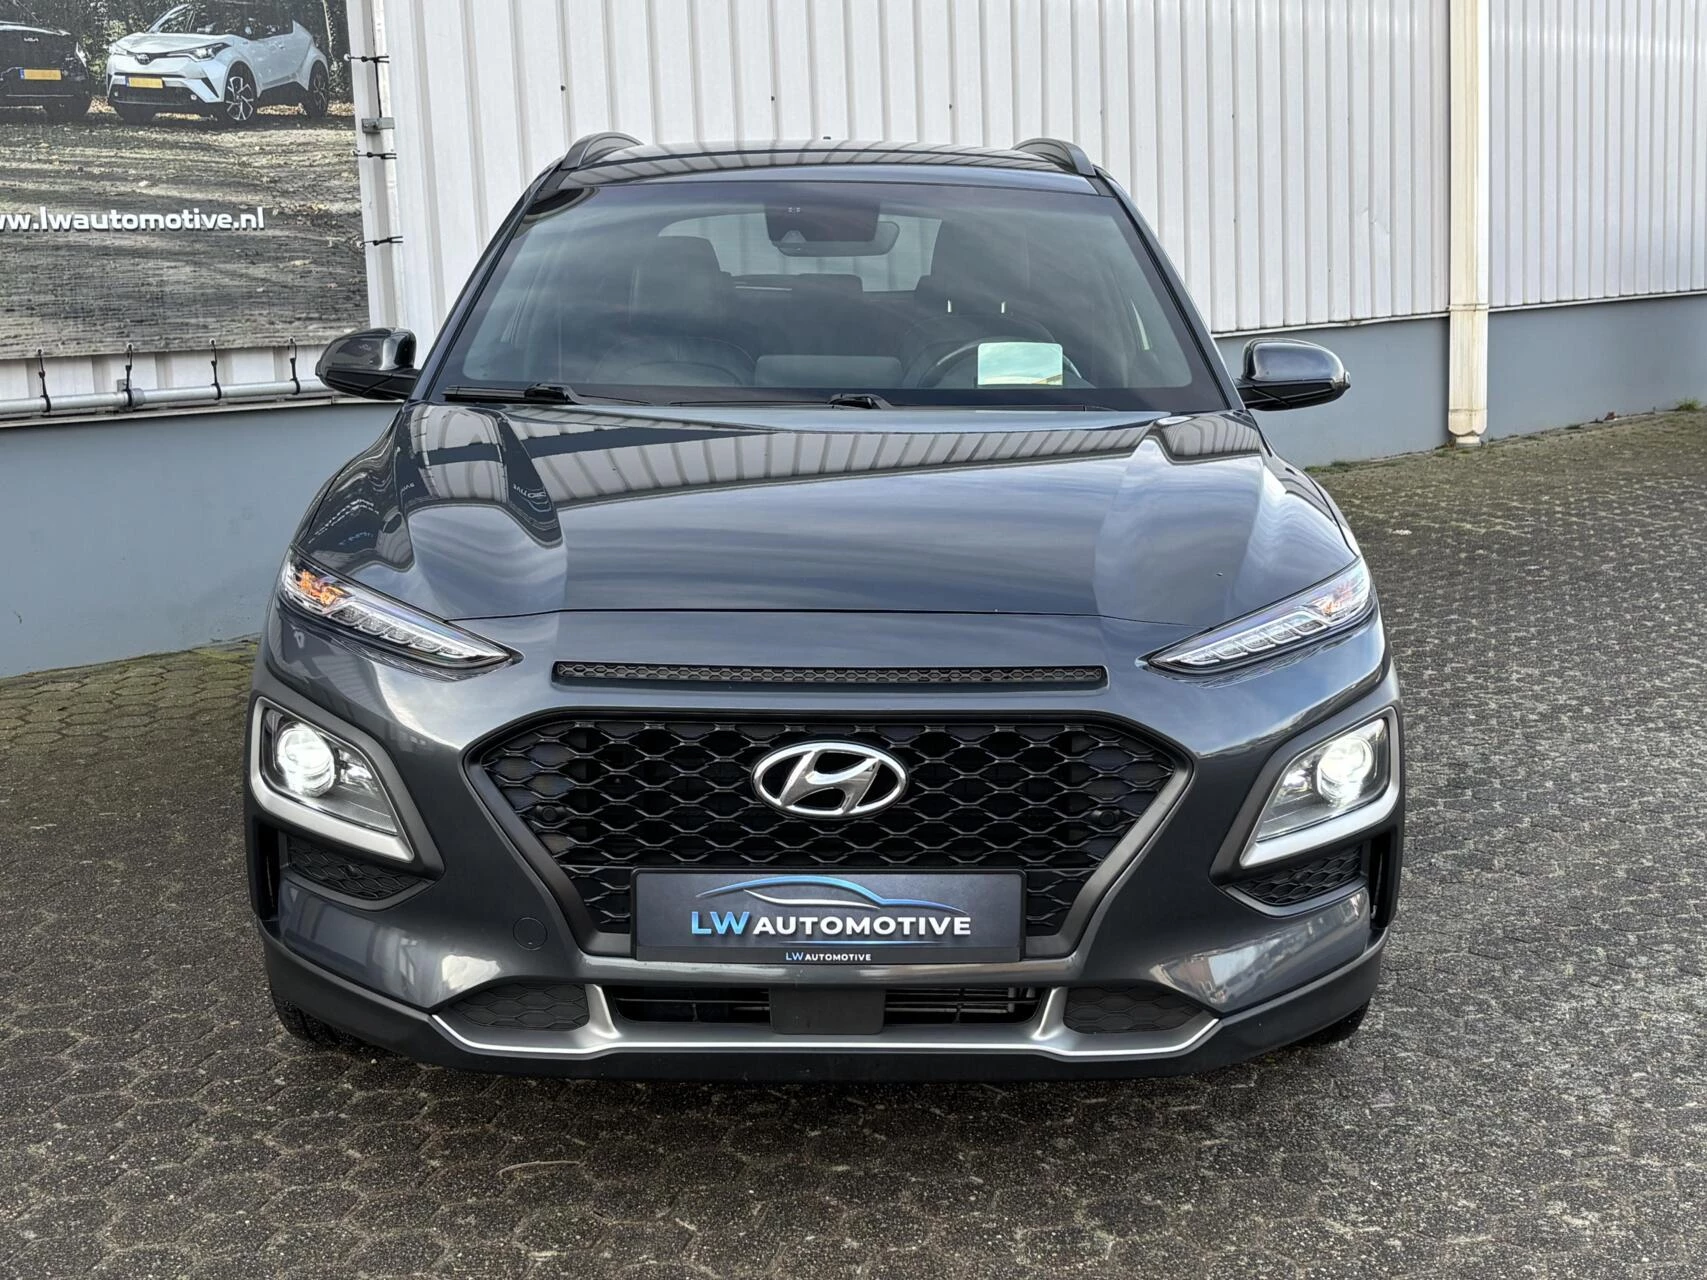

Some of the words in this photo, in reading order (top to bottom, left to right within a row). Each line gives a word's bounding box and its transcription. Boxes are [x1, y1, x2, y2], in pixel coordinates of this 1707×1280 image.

[691, 911, 750, 935] LW
[752, 916, 971, 935] AUTOMOTIVE
[804, 953, 872, 961] AUTOMOTIVE
